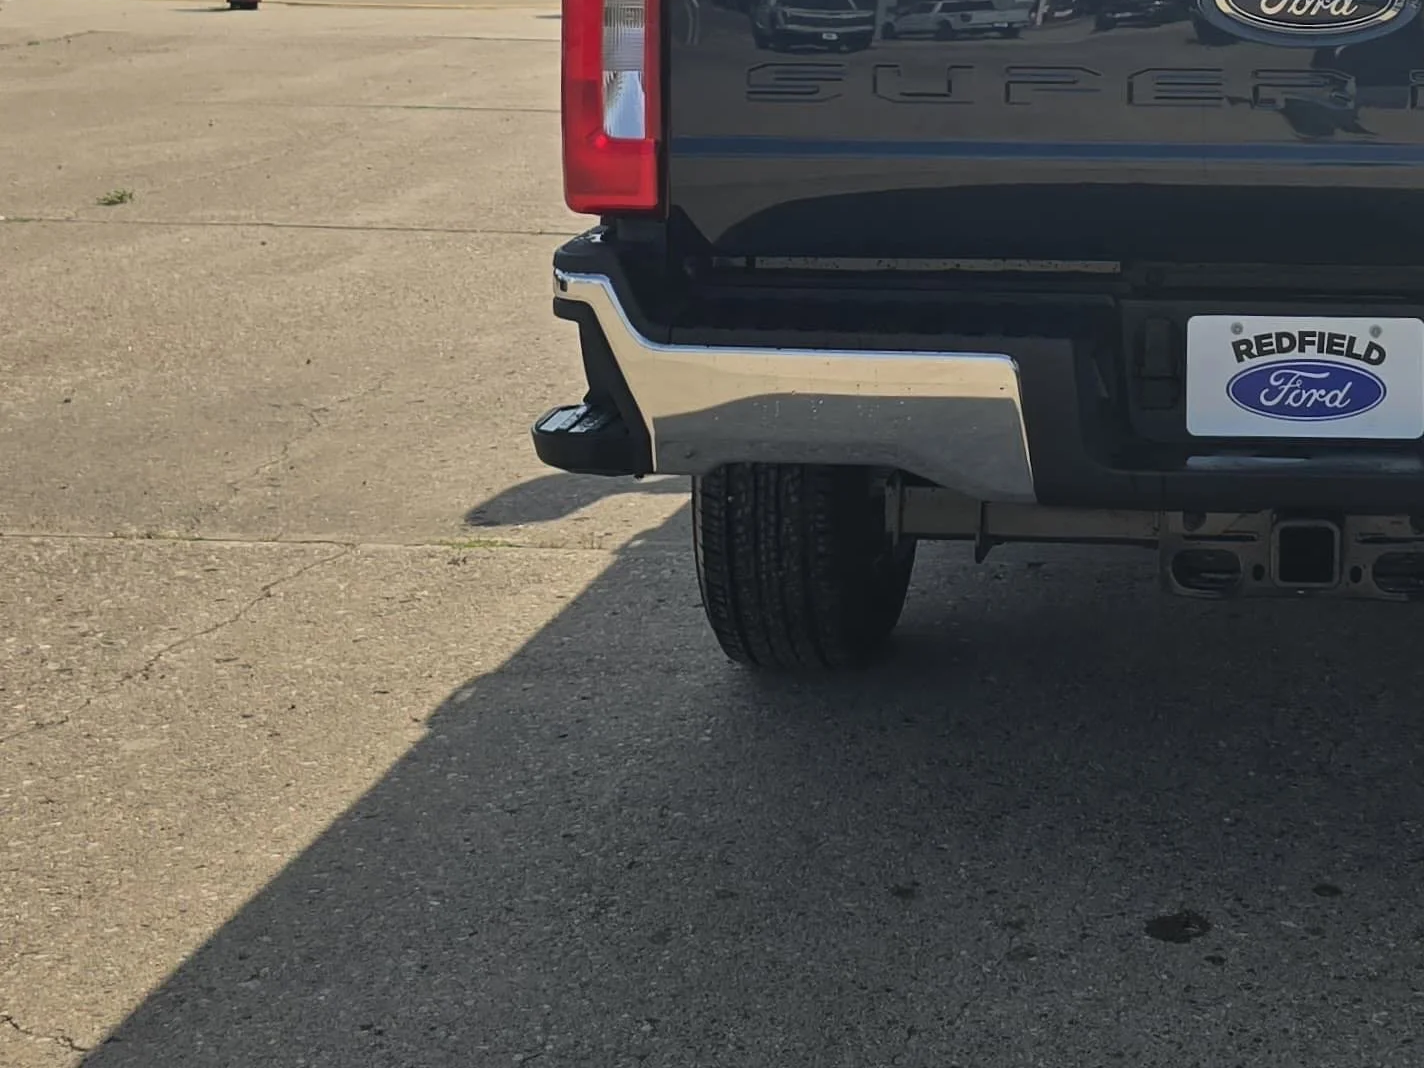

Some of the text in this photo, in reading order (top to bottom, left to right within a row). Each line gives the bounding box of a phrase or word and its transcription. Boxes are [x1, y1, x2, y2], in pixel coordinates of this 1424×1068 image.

[746, 63, 1356, 111] SUPER
[1230, 330, 1387, 366] REDFIELD
[1259, 368, 1353, 409] Ford
